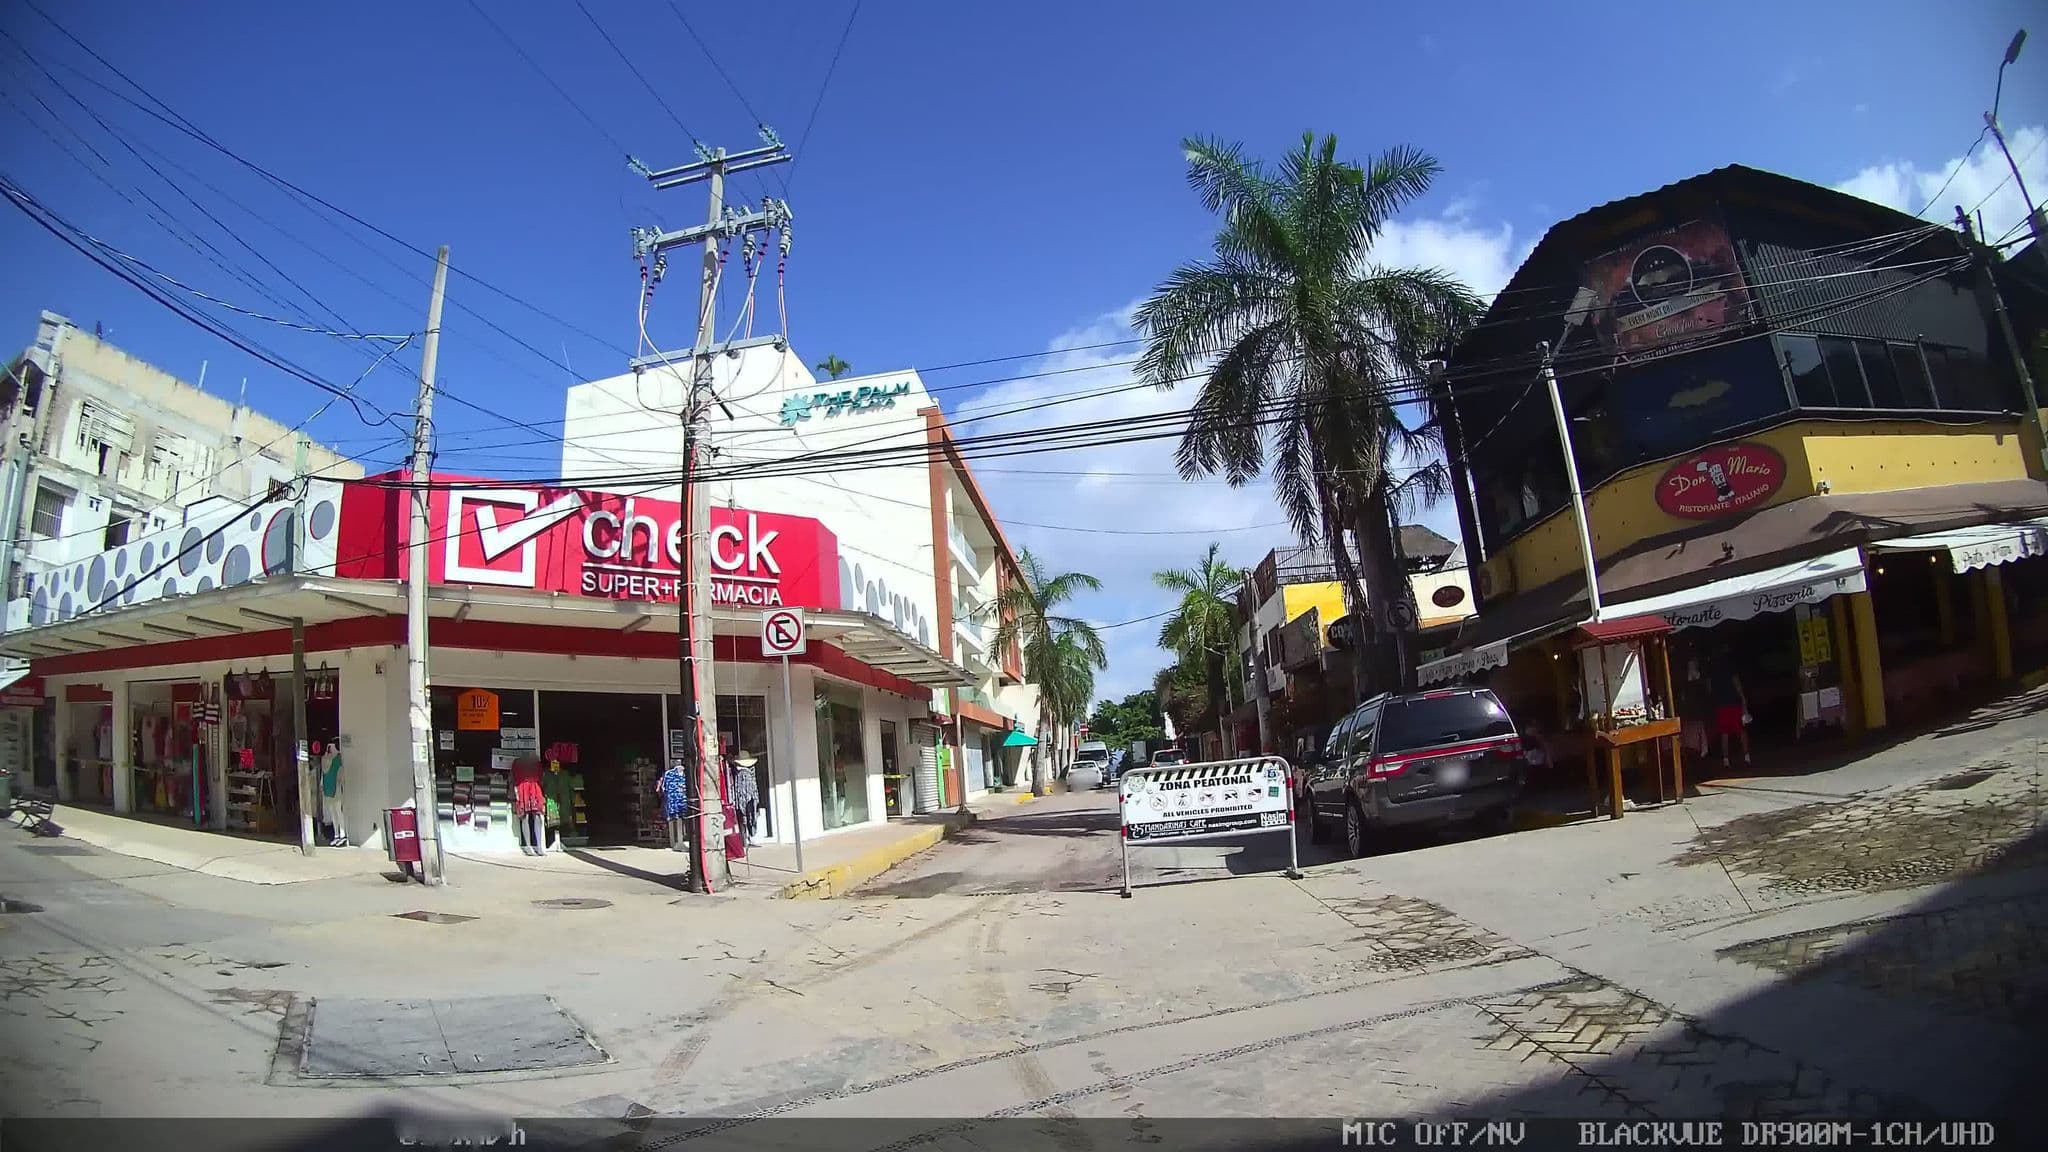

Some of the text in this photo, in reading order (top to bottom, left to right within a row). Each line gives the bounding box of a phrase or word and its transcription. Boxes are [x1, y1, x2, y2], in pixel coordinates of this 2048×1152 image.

[813, 382, 910, 406] THE PALM
[1669, 456, 1771, 497] Don Mario
[1679, 484, 1769, 513] RISTORANTE ITALIANO
[581, 571, 783, 607] SUPER+FMACIA
[1159, 780, 1191, 792] ZONA
[1194, 775, 1253, 789] PEATONAL
[1176, 807, 1209, 817] VEHICLES
[1211, 804, 1253, 814] PROHIBITED
[1260, 811, 1287, 823] Nasim
